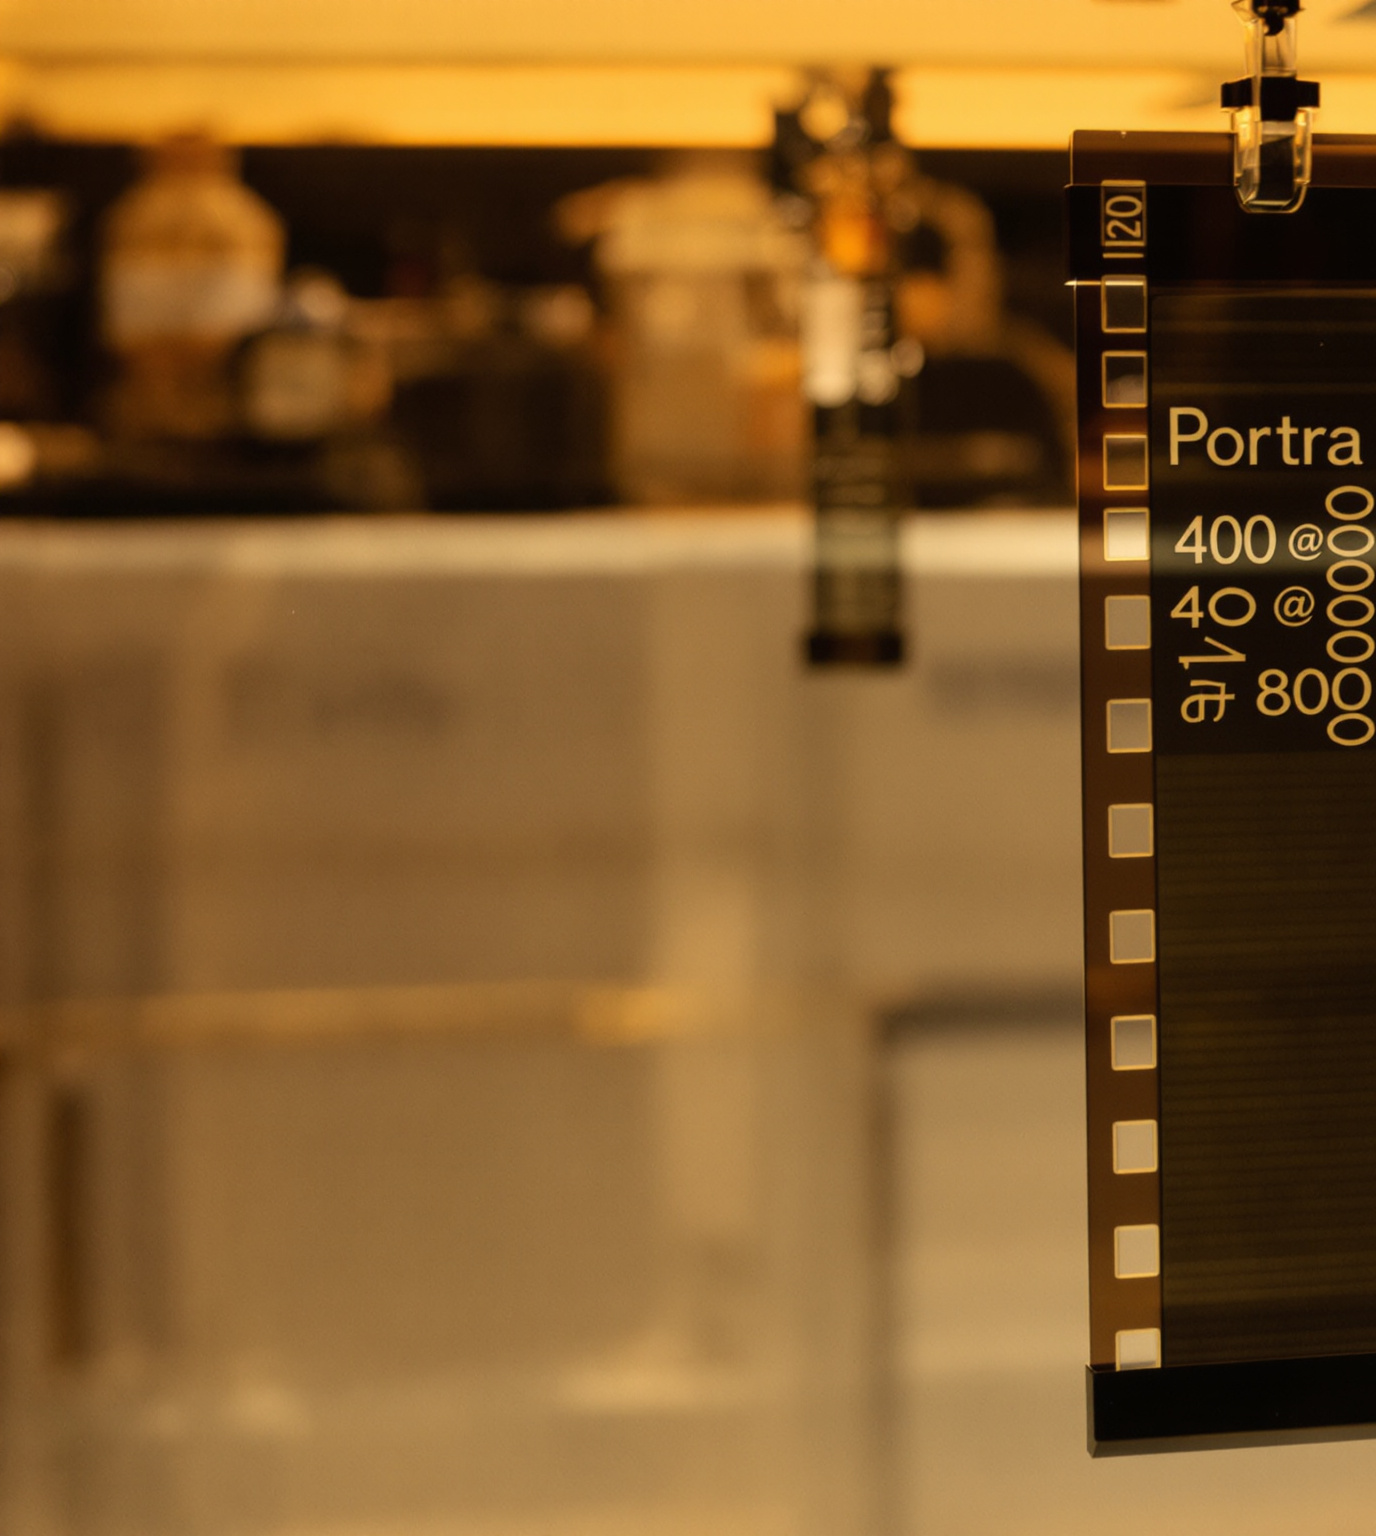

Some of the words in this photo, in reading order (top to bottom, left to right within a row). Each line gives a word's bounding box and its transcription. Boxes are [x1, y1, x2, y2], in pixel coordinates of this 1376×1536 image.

[1169, 406, 1363, 467] Portra
[1174, 514, 1277, 565] 400
[1170, 585, 1257, 629] 40
